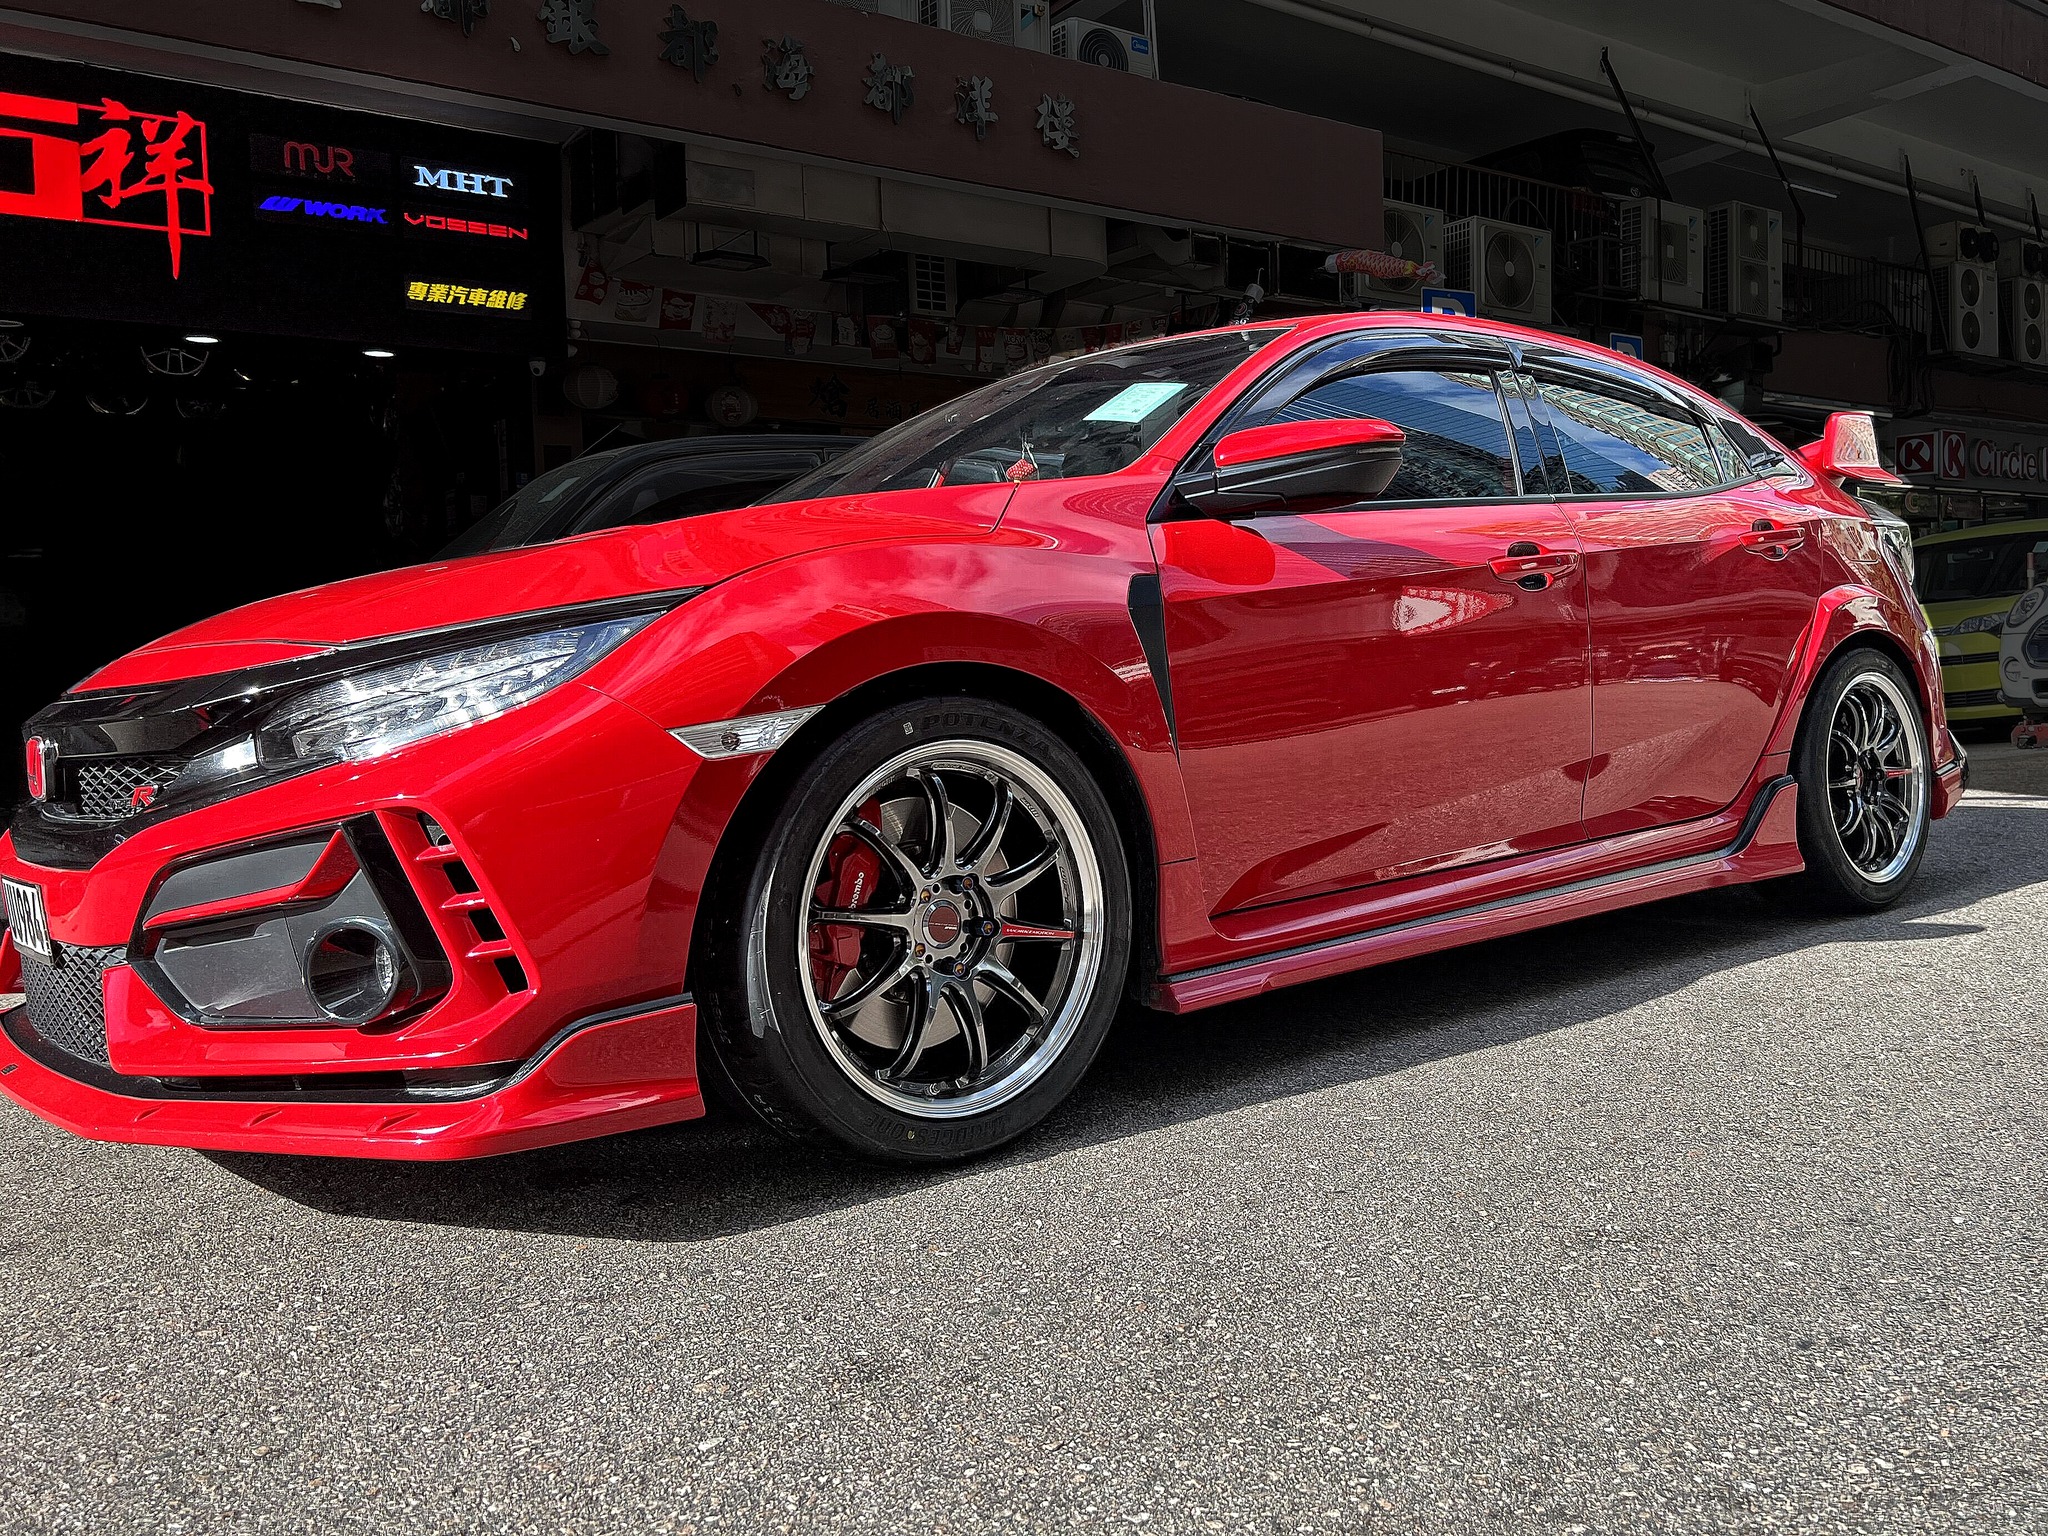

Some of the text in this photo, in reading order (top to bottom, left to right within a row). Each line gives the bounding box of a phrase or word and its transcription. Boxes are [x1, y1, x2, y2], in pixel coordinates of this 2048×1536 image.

[413, 165, 514, 198] MHT
[303, 199, 389, 224] WORK
[403, 212, 529, 241] VOSSEN
[406, 281, 528, 310] 專業汽車維修
[1946, 437, 1966, 474] K
[1975, 438, 2038, 480] Circle
[922, 711, 1052, 761] POTENZA
[131, 785, 158, 807] R
[848, 871, 865, 909] brembo
